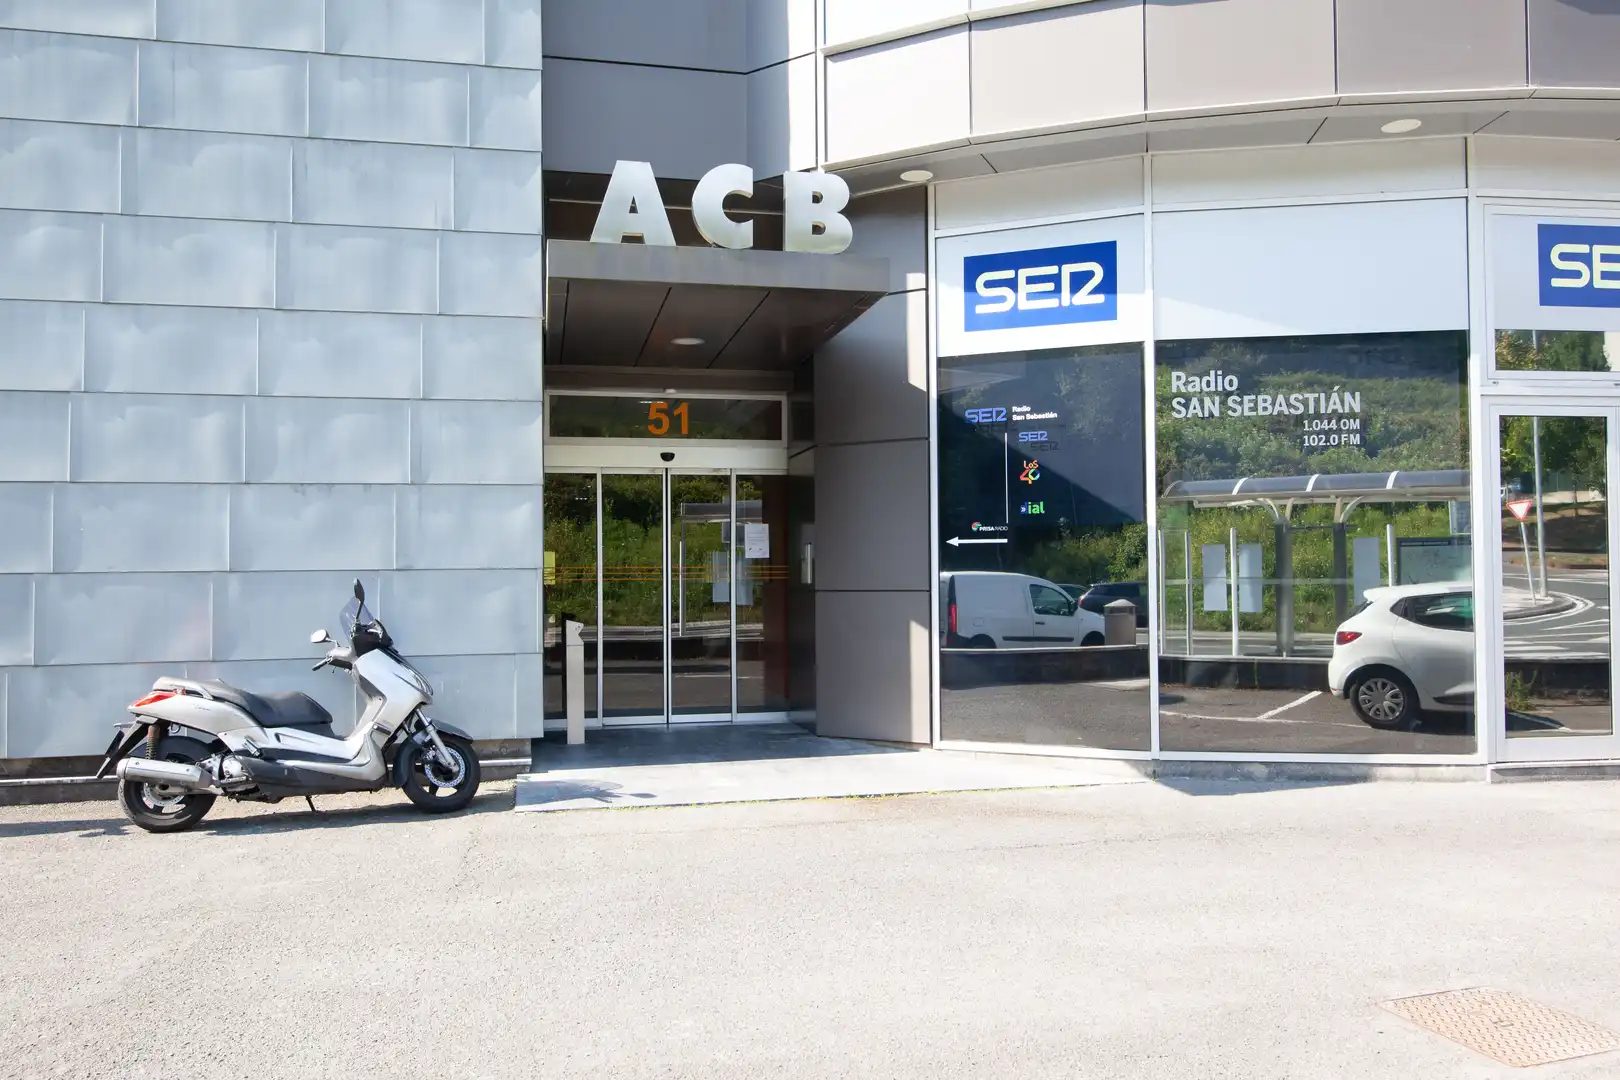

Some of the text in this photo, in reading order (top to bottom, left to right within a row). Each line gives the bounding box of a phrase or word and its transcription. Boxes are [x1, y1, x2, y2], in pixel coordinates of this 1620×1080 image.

[590, 160, 853, 254] ACB
[975, 261, 1106, 315] SER
[1171, 370, 1239, 393] Radio
[1171, 386, 1361, 419] SAN SEBASTIÁN
[647, 403, 690, 436] 51
[964, 407, 1007, 422] SER
[1026, 412, 1058, 420] Sebastián
[1303, 419, 1360, 431] 1.044 OM
[1018, 431, 1048, 442] SER
[1303, 434, 1361, 446] 102.0 FM
[1020, 468, 1040, 484] 40
